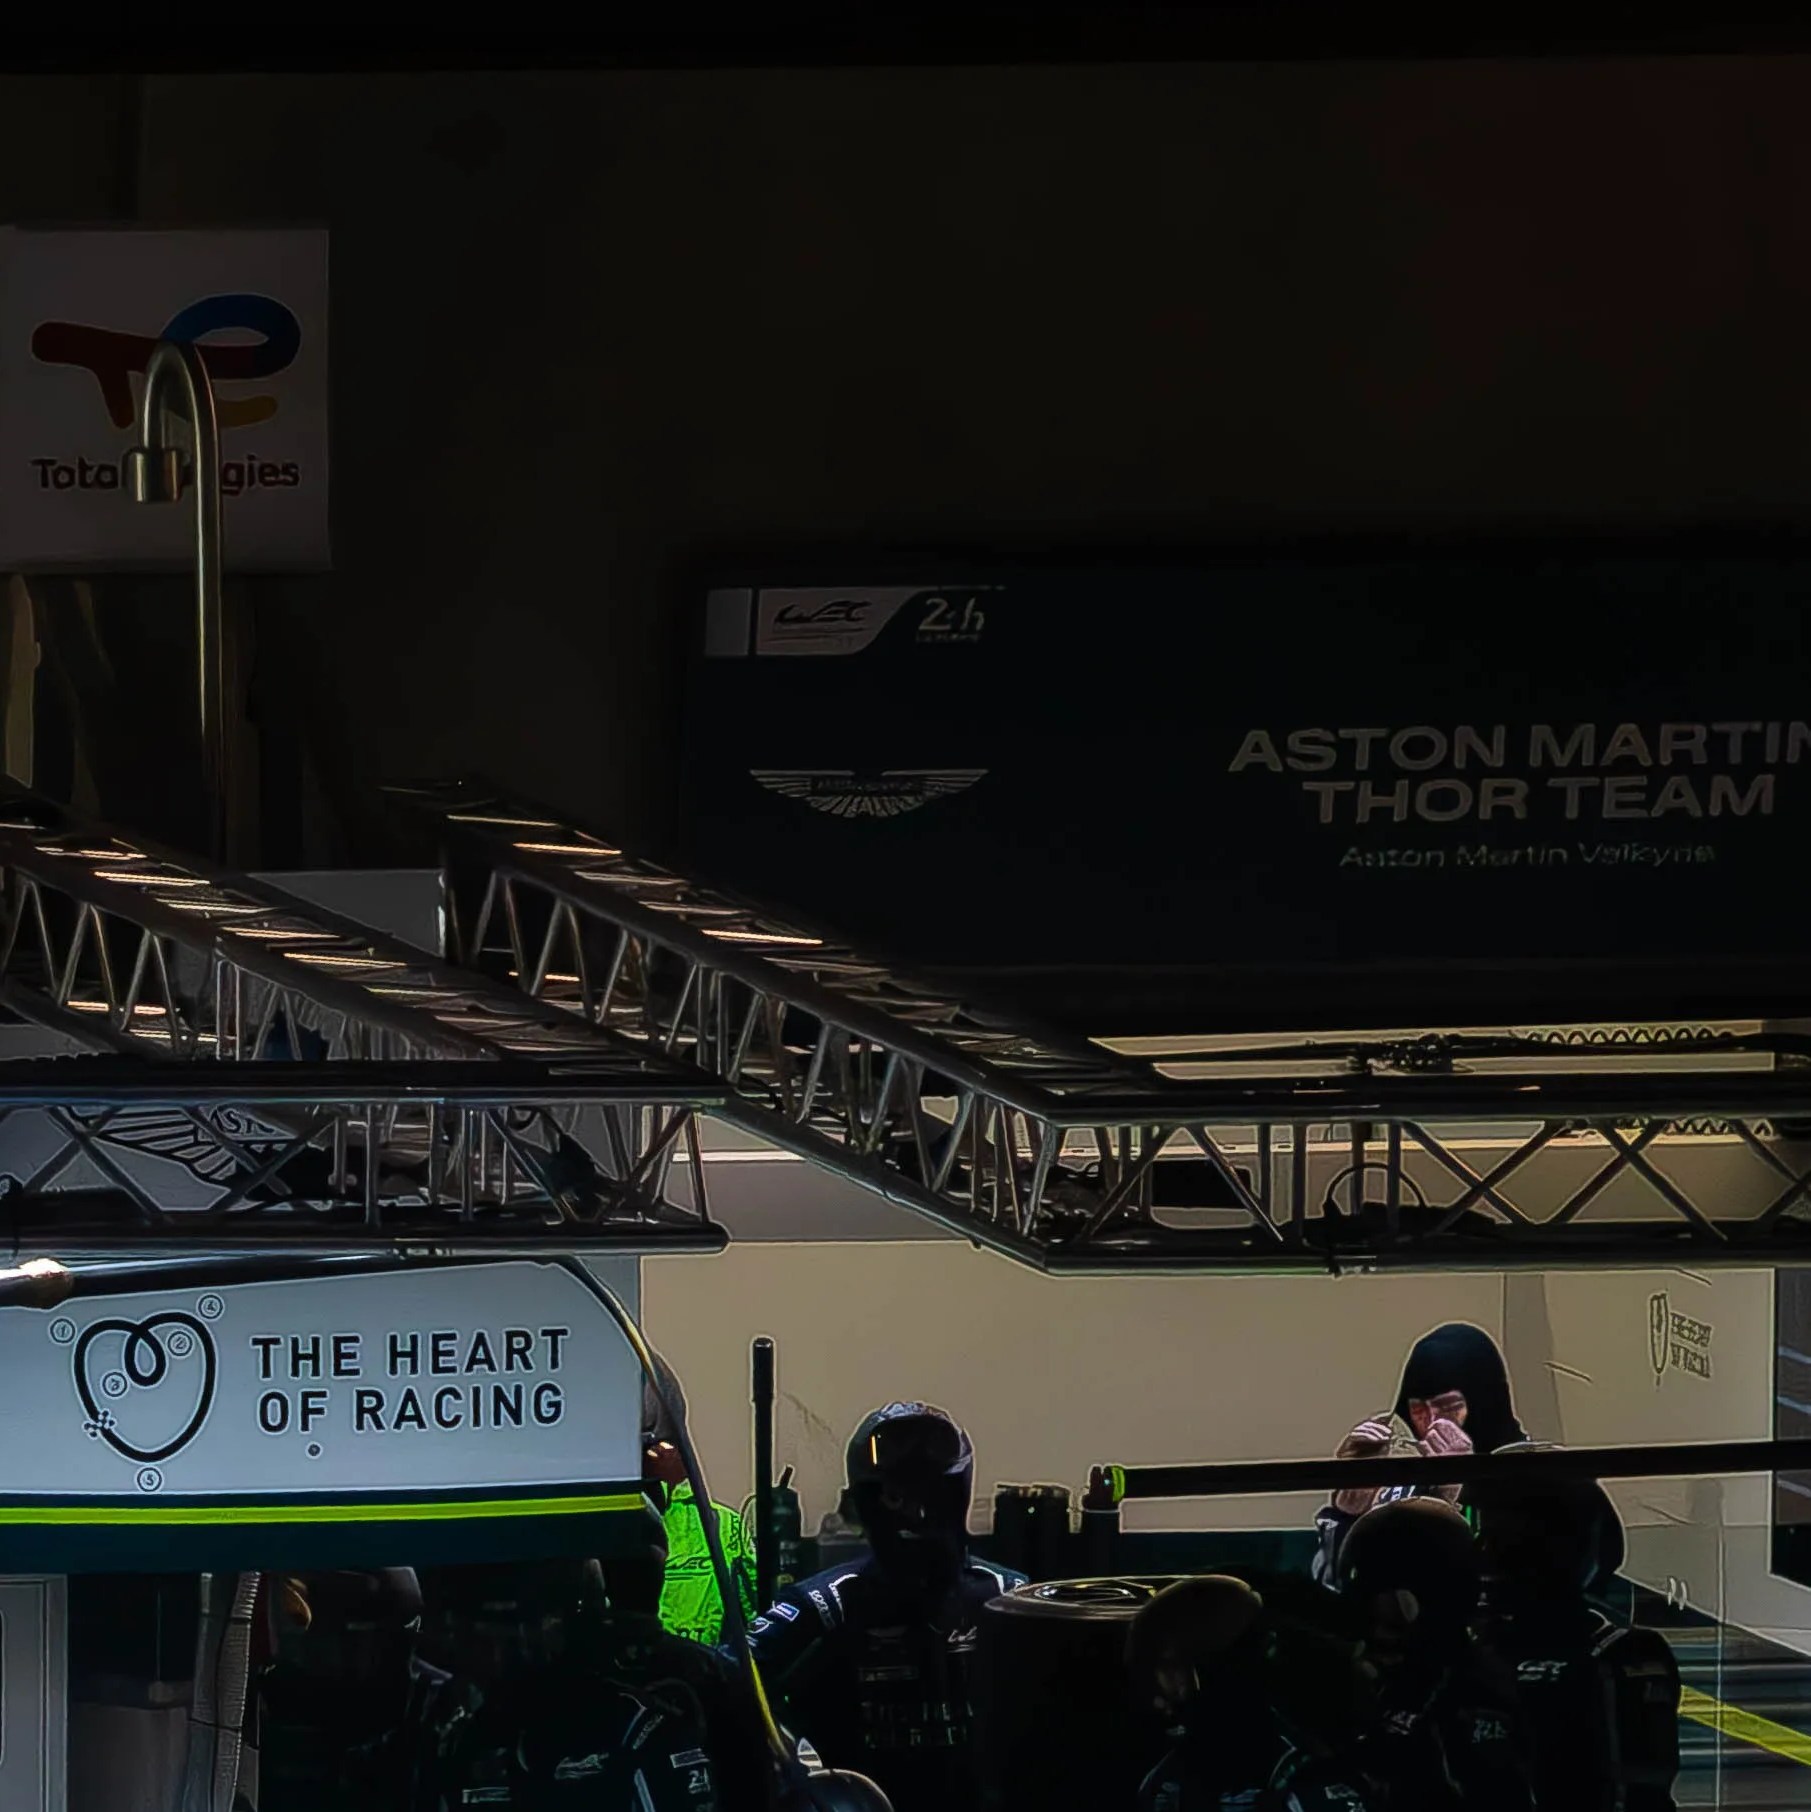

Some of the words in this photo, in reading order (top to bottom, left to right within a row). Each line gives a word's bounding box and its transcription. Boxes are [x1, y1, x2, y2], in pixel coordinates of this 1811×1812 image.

[31, 454, 299, 496] Totagies
[1229, 724, 1506, 772] ASTON
[1302, 778, 1530, 824] THOR
[1547, 774, 1776, 820] TEAM
[1456, 844, 1568, 867] Martin
[250, 1334, 363, 1378] THE
[387, 1328, 569, 1376] HEART
[258, 1390, 328, 1434] OF
[354, 1383, 565, 1432] RACING
